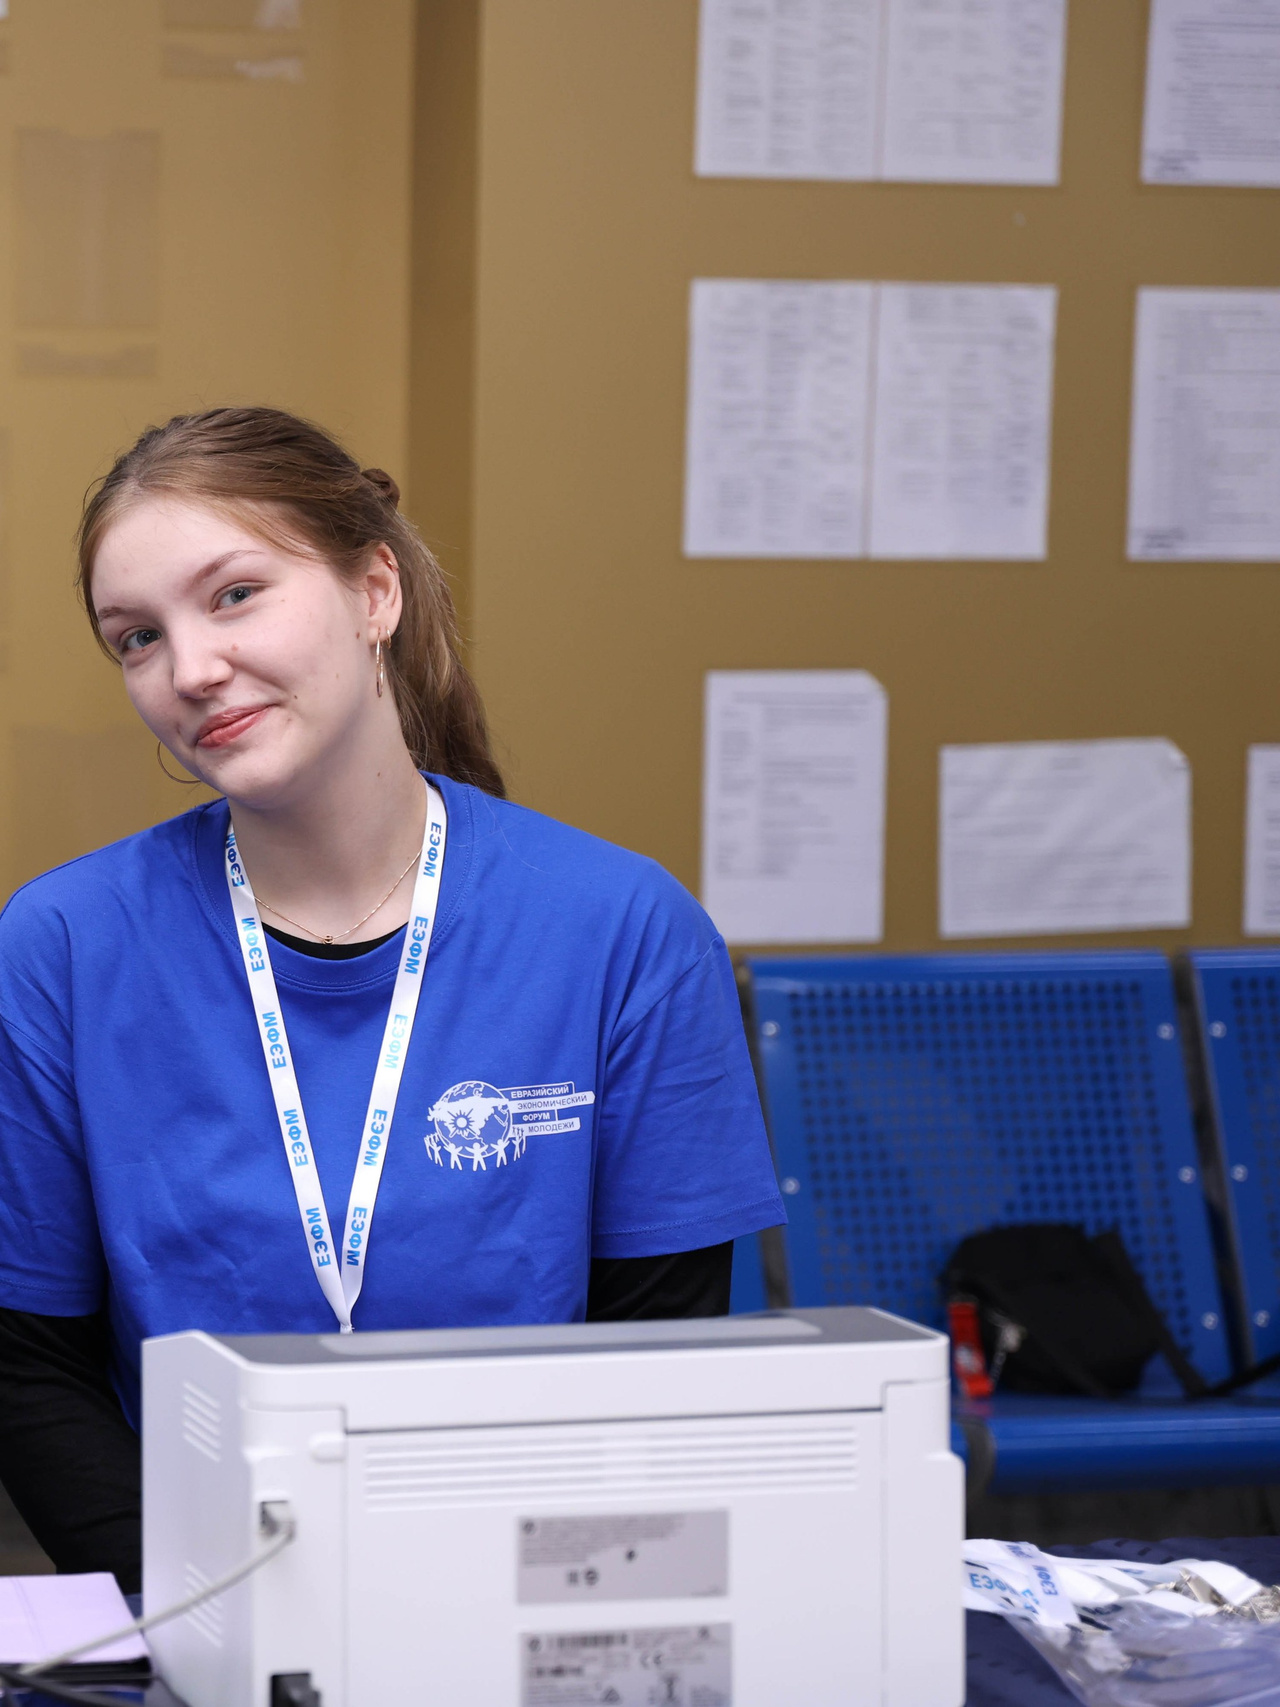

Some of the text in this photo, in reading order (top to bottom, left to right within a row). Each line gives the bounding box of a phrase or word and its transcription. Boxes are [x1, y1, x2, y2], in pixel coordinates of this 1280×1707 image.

[423, 821, 442, 878] ЕЭФМ
[241, 916, 266, 973] ЕЭФМ
[404, 915, 429, 975] ЕЭФМ
[262, 1011, 287, 1069] ЕЭФМ
[383, 1013, 408, 1069] ЕЭФМ
[510, 1084, 570, 1099] ЕВРАЗИЙСКИЙ
[517, 1094, 588, 1110] ЭКОНОМИЧЕСКИЙ
[522, 1112, 551, 1122] ФОРУМ
[282, 1108, 309, 1167] ЕЭФМ
[363, 1108, 388, 1167] ЕЭФМ
[528, 1121, 575, 1133] МОЛОДЕЖИ
[305, 1207, 332, 1268] ЕЭФМ
[346, 1206, 368, 1267] ЕЭФМ
